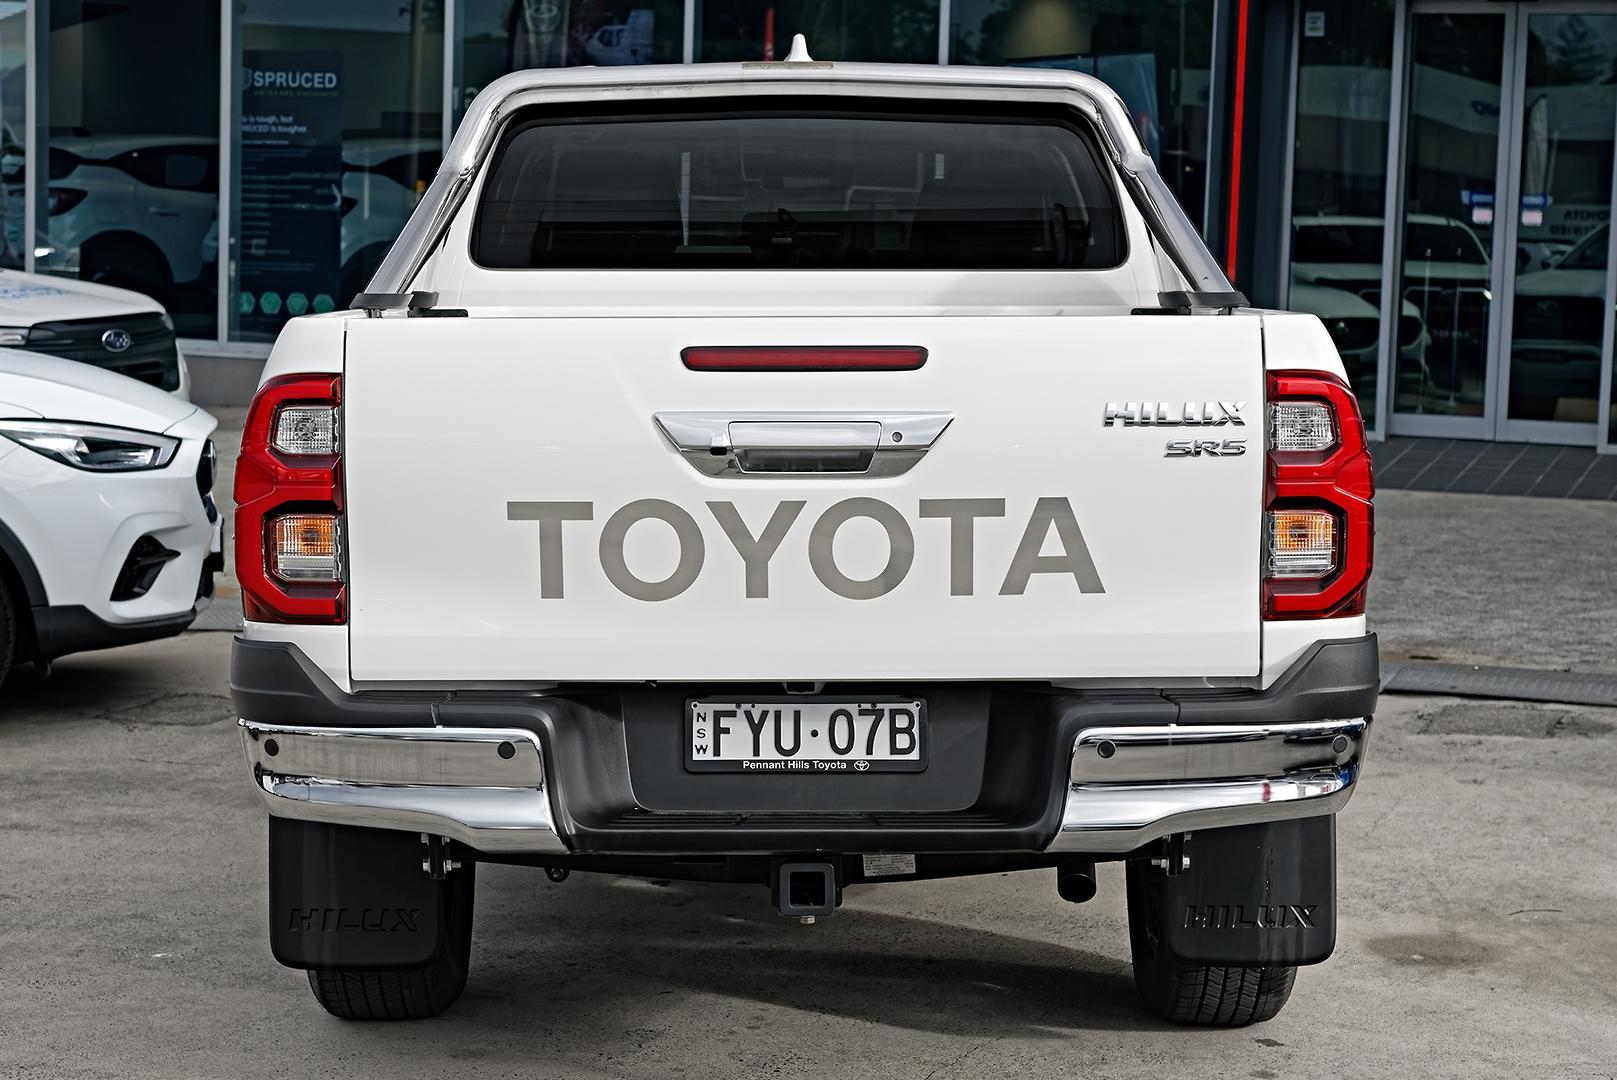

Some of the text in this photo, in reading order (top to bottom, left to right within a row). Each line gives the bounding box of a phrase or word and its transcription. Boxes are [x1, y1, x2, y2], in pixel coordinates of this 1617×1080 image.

[253, 71, 337, 88] SPRUCED
[1103, 401, 1248, 427] HILUX
[1164, 439, 1248, 457] SR5
[507, 497, 1106, 602] TOYOTA
[743, 760, 847, 771] Pennant Hills Toyota
[289, 908, 422, 932] HILUX
[1184, 904, 1318, 928] HILUX
